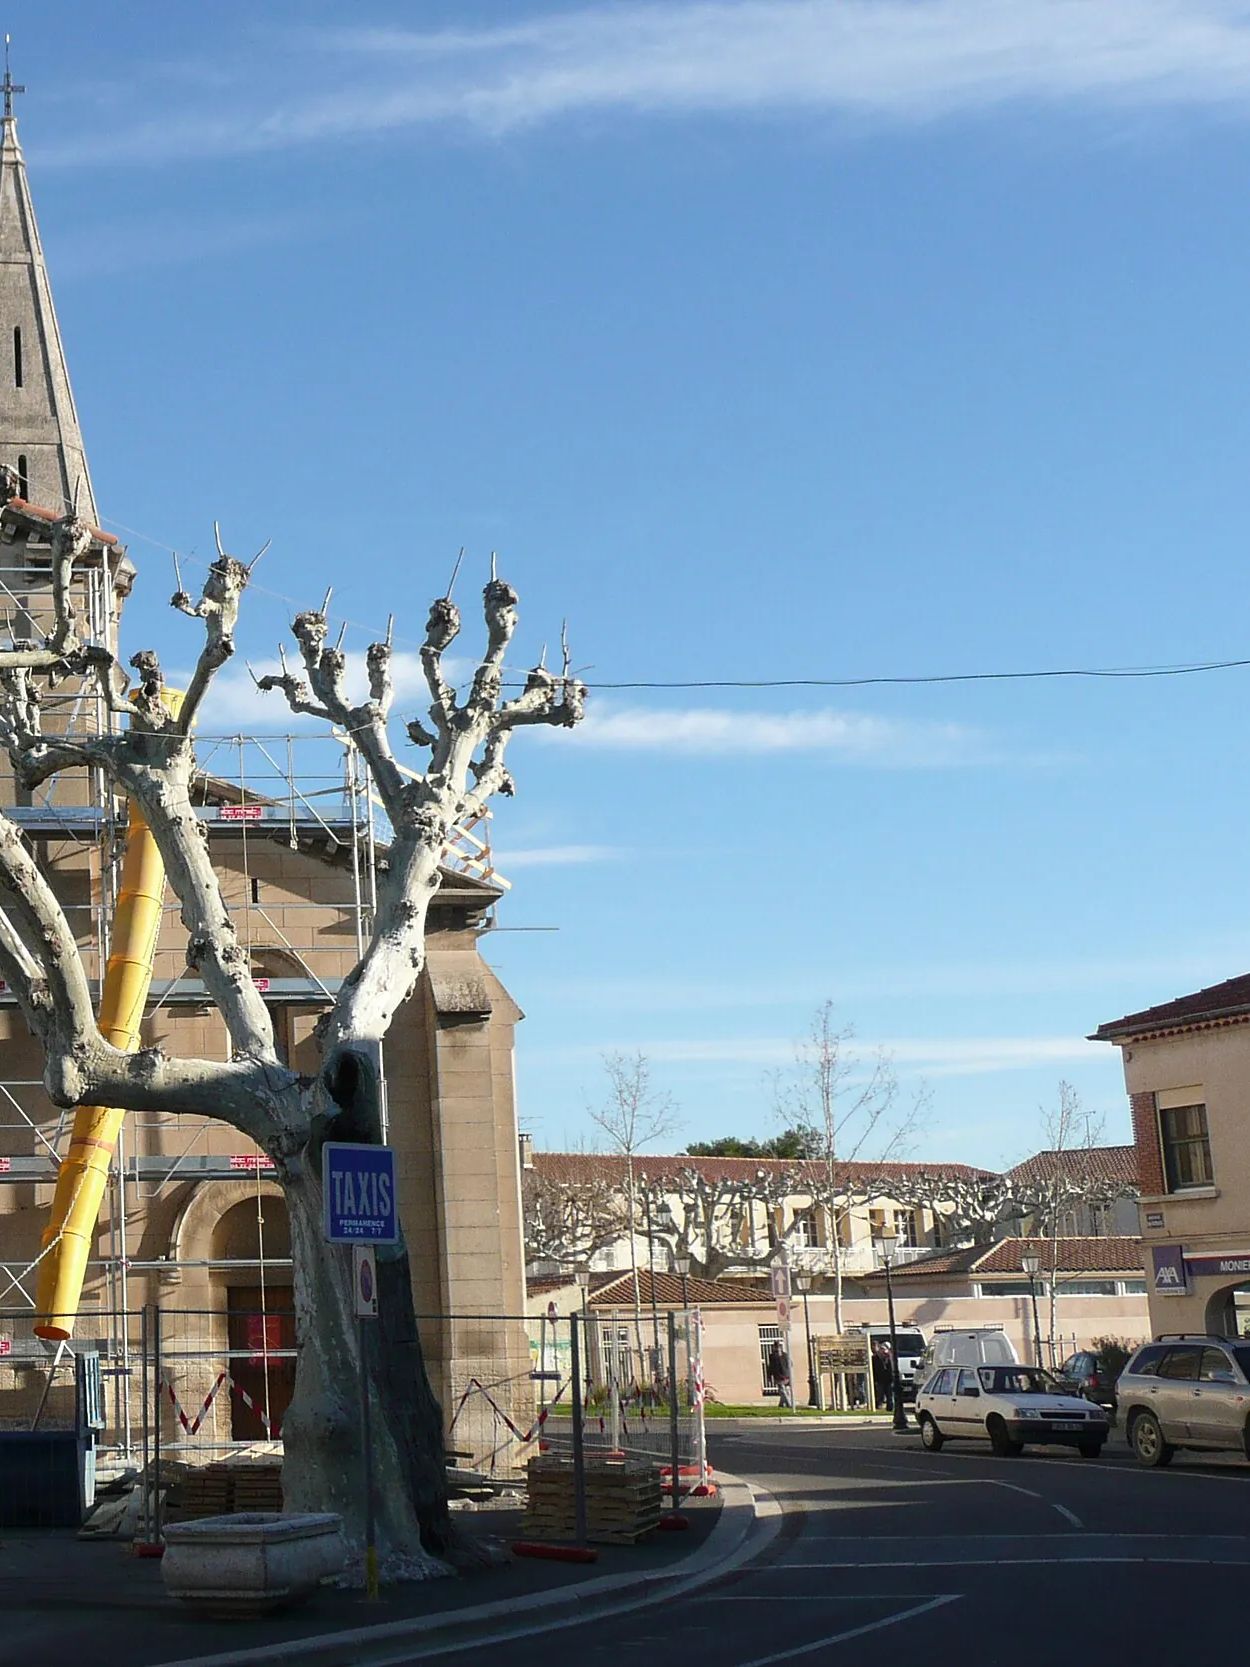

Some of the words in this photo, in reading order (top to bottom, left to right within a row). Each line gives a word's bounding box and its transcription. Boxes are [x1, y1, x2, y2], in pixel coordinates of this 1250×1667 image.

[332, 1171, 391, 1217] TAXIS
[339, 1219, 385, 1228] PERMANENCE
[1220, 1260, 1250, 1272] MONIE
[1155, 1266, 1180, 1284] AXA
